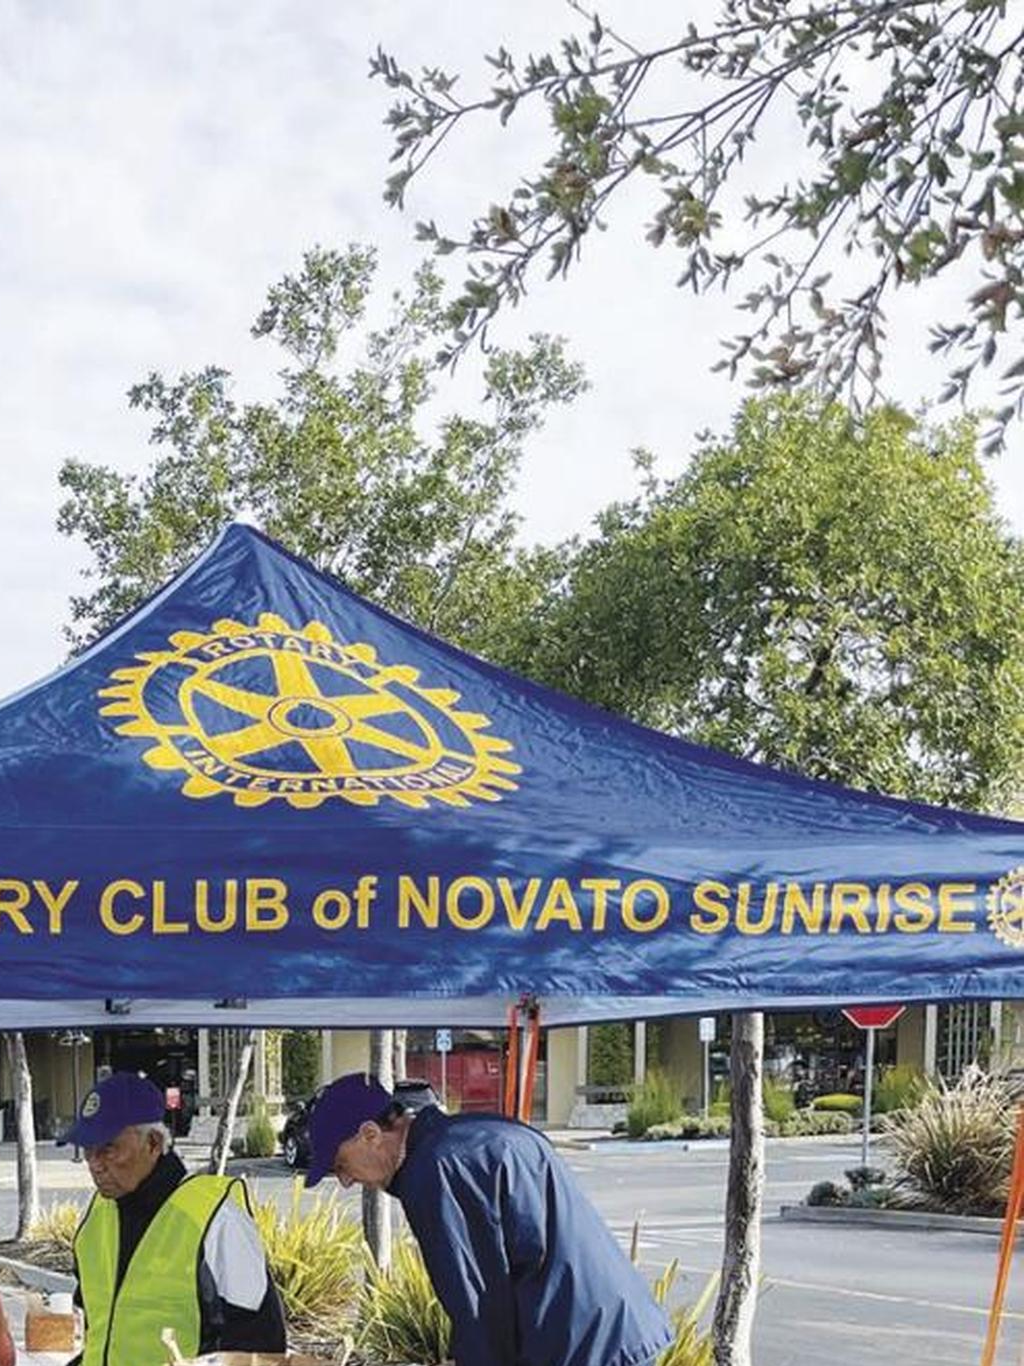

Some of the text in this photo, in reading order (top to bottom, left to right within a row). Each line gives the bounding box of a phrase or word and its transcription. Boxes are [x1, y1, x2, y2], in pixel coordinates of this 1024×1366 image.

[202, 633, 358, 666] ROTARY
[184, 750, 472, 793] INTERNATIONAL
[98, 878, 290, 935] CLUB
[311, 876, 377, 931] of
[398, 875, 671, 932] NOVATO
[690, 880, 977, 935] SUNRISE
